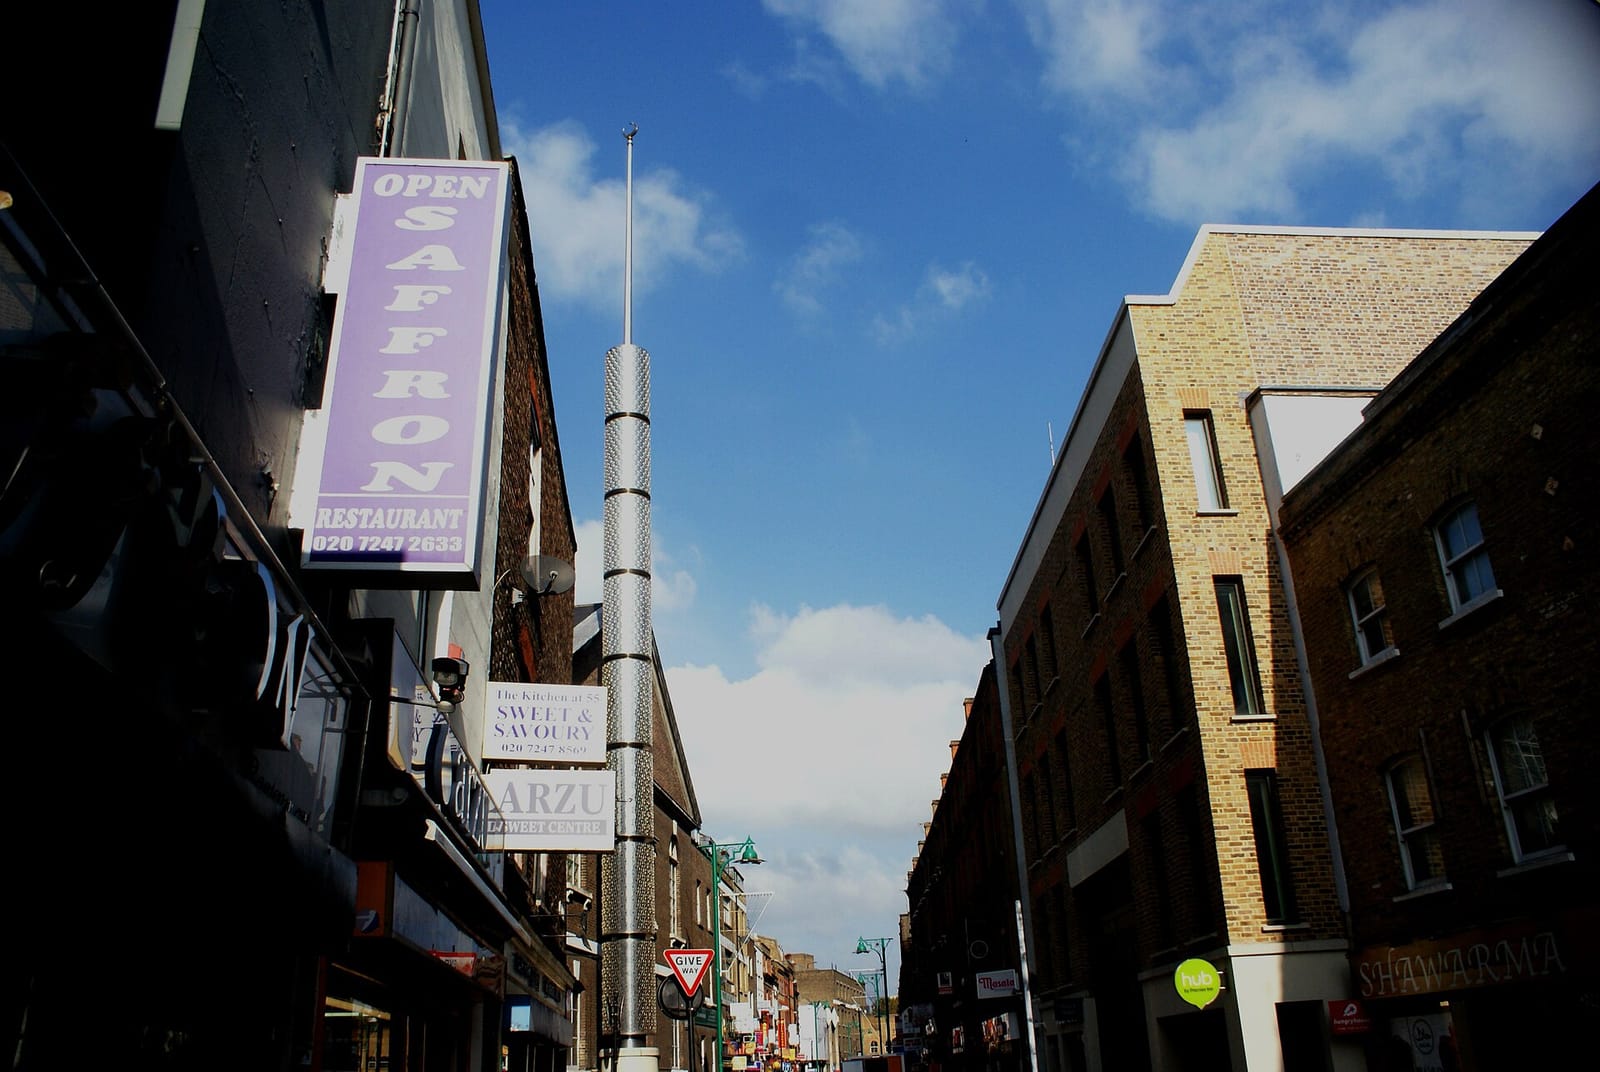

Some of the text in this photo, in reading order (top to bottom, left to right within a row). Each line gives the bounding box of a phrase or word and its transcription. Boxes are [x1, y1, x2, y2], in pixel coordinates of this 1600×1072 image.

[373, 173, 491, 199] OPEN
[360, 205, 467, 492] SAFFRON
[315, 507, 464, 529] RESTAURANT
[312, 535, 463, 552] 020 7247 2633
[497, 690, 518, 700] The
[522, 691, 567, 702] Kitchen
[497, 706, 592, 723] SWEET &
[494, 723, 594, 740] SAVOURY
[501, 743, 523, 752] 020
[528, 744, 555, 753] 7247
[499, 781, 608, 815] ARZU
[548, 821, 601, 833] CENTRE
[675, 956, 702, 966] GIVE
[1359, 931, 1568, 997] SHAWARMA
[978, 977, 1015, 990] Masala
[1181, 970, 1213, 987] hub
